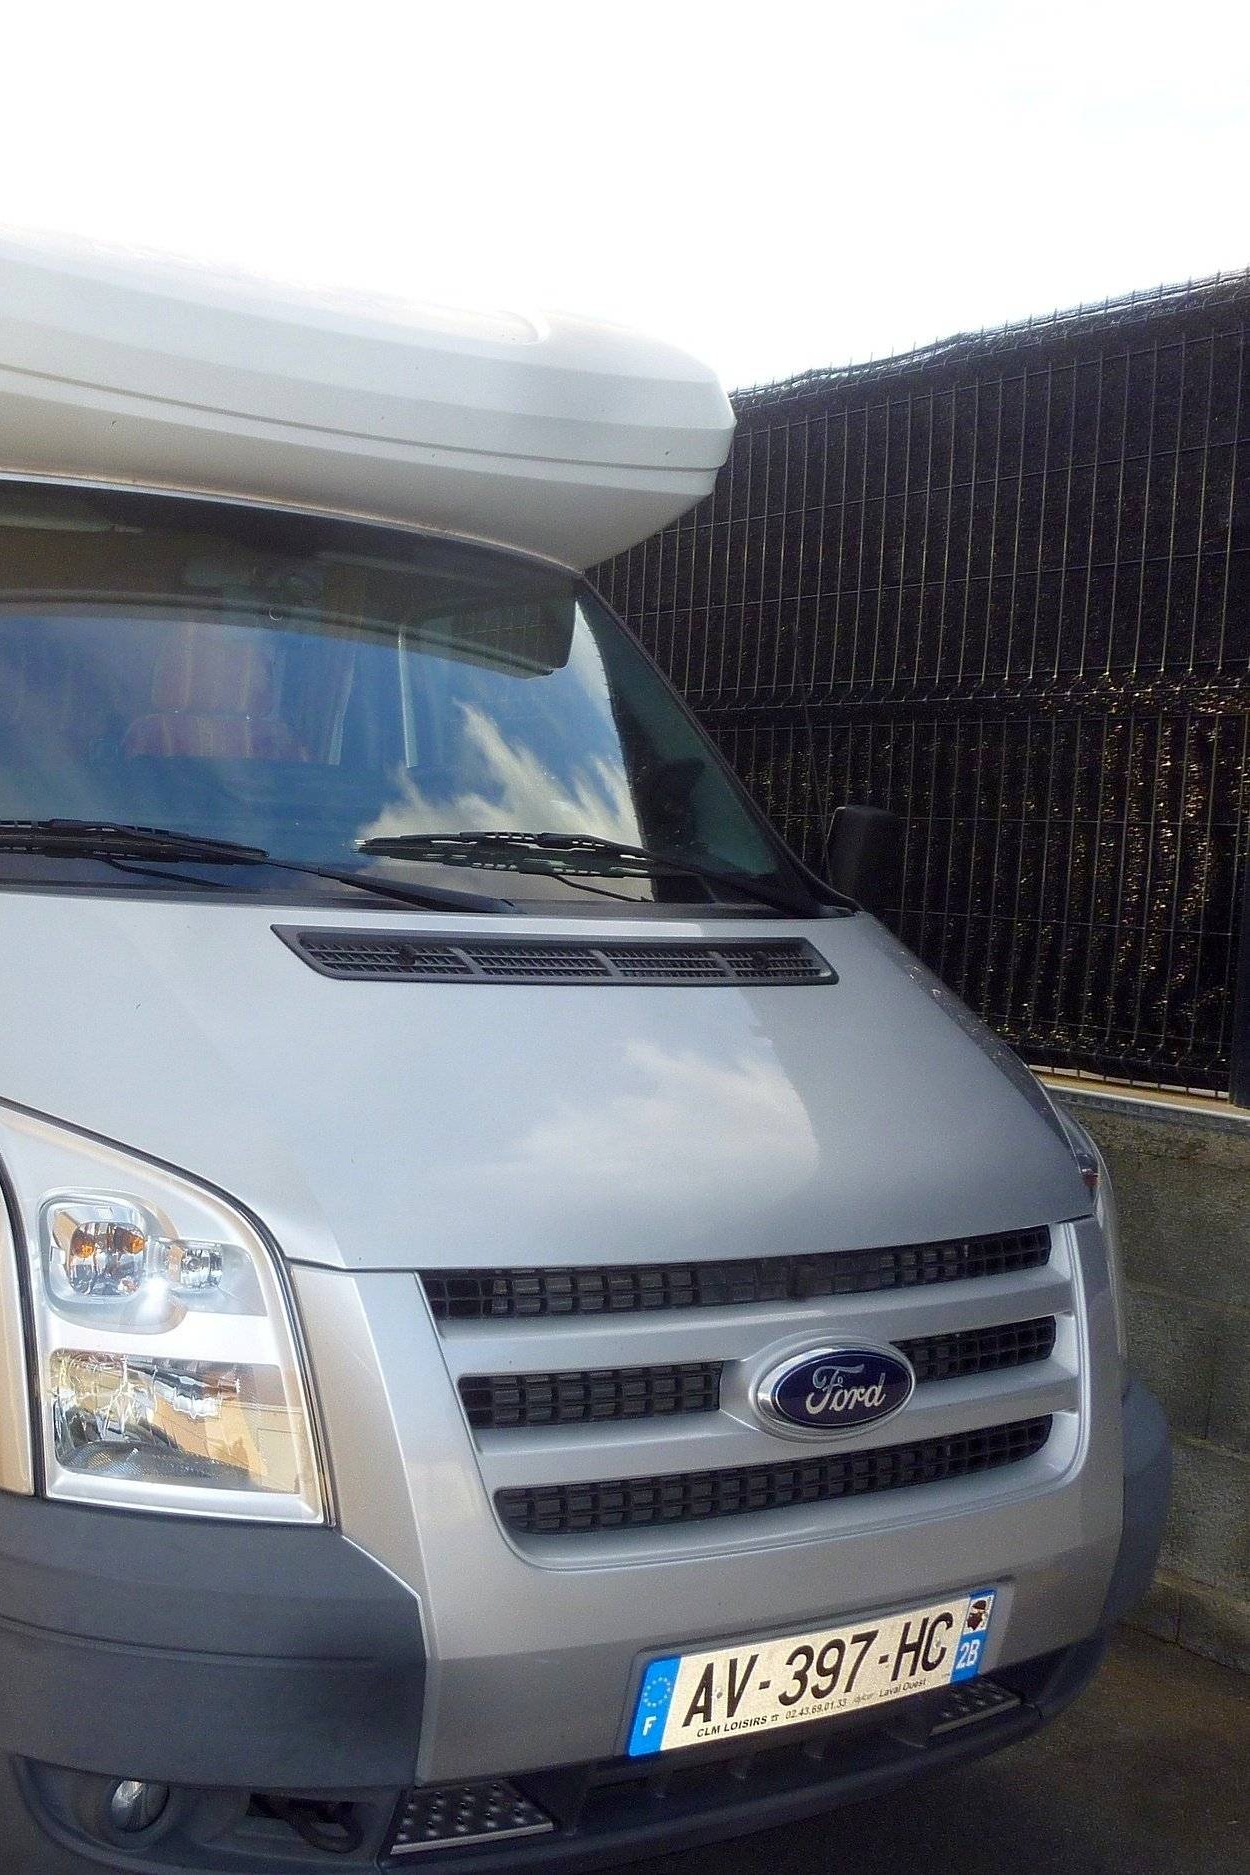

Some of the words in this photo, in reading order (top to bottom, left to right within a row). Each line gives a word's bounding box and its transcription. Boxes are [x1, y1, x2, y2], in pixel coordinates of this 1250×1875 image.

[805, 1363, 886, 1415] Ford
[682, 1612, 954, 1728] AV-397-HC
[955, 1638, 981, 1669] 2B
[642, 1715, 657, 1737] F
[696, 1724, 721, 1738] CLM
[723, 1715, 767, 1733] LOISIRS
[879, 1684, 901, 1698] Laval
[902, 1677, 927, 1692] Ouest
